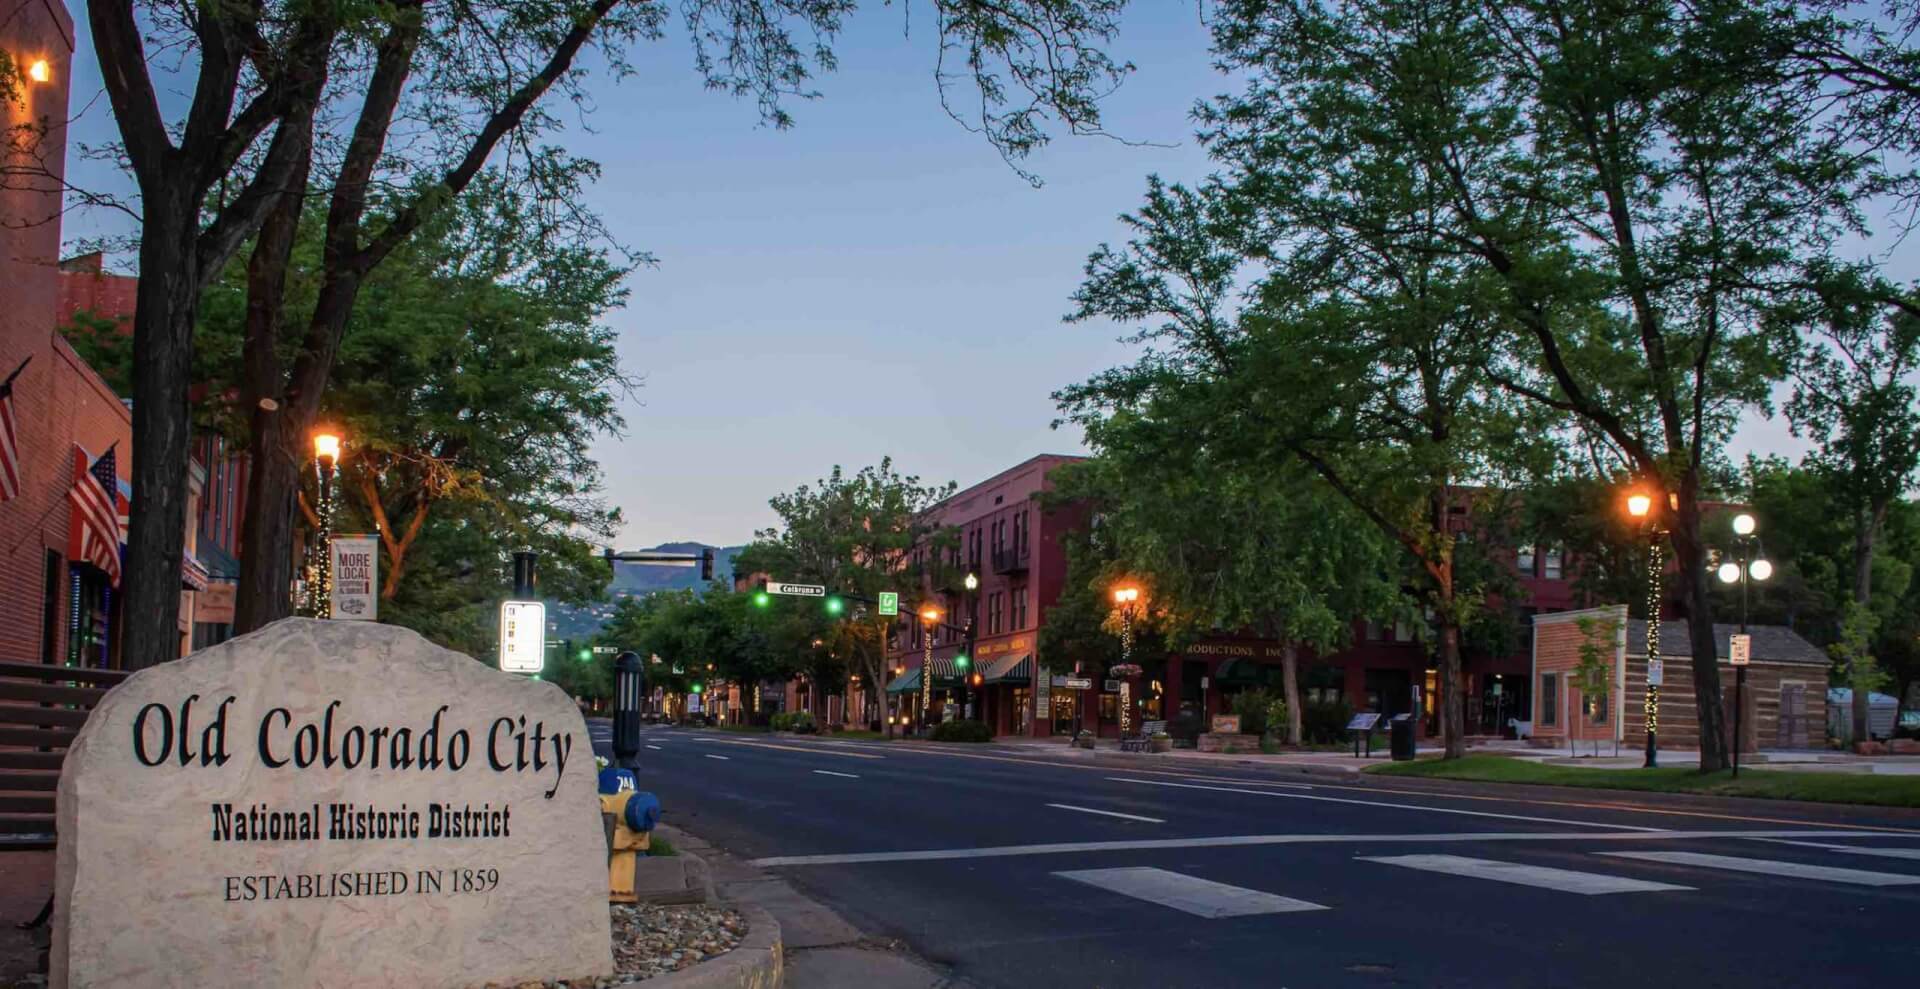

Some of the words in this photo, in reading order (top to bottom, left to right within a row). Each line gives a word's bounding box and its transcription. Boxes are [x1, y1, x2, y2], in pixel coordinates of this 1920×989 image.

[339, 554, 370, 566] MORE
[339, 567, 370, 579] LOCAL
[132, 694, 236, 767] Old
[258, 700, 471, 770] Colorado
[487, 714, 572, 799] City
[212, 803, 320, 841] National
[329, 803, 420, 840] Historic
[429, 803, 511, 838] District
[224, 872, 408, 901] ESTABLISHED
[417, 870, 443, 893] IN
[452, 868, 500, 892] 1859
